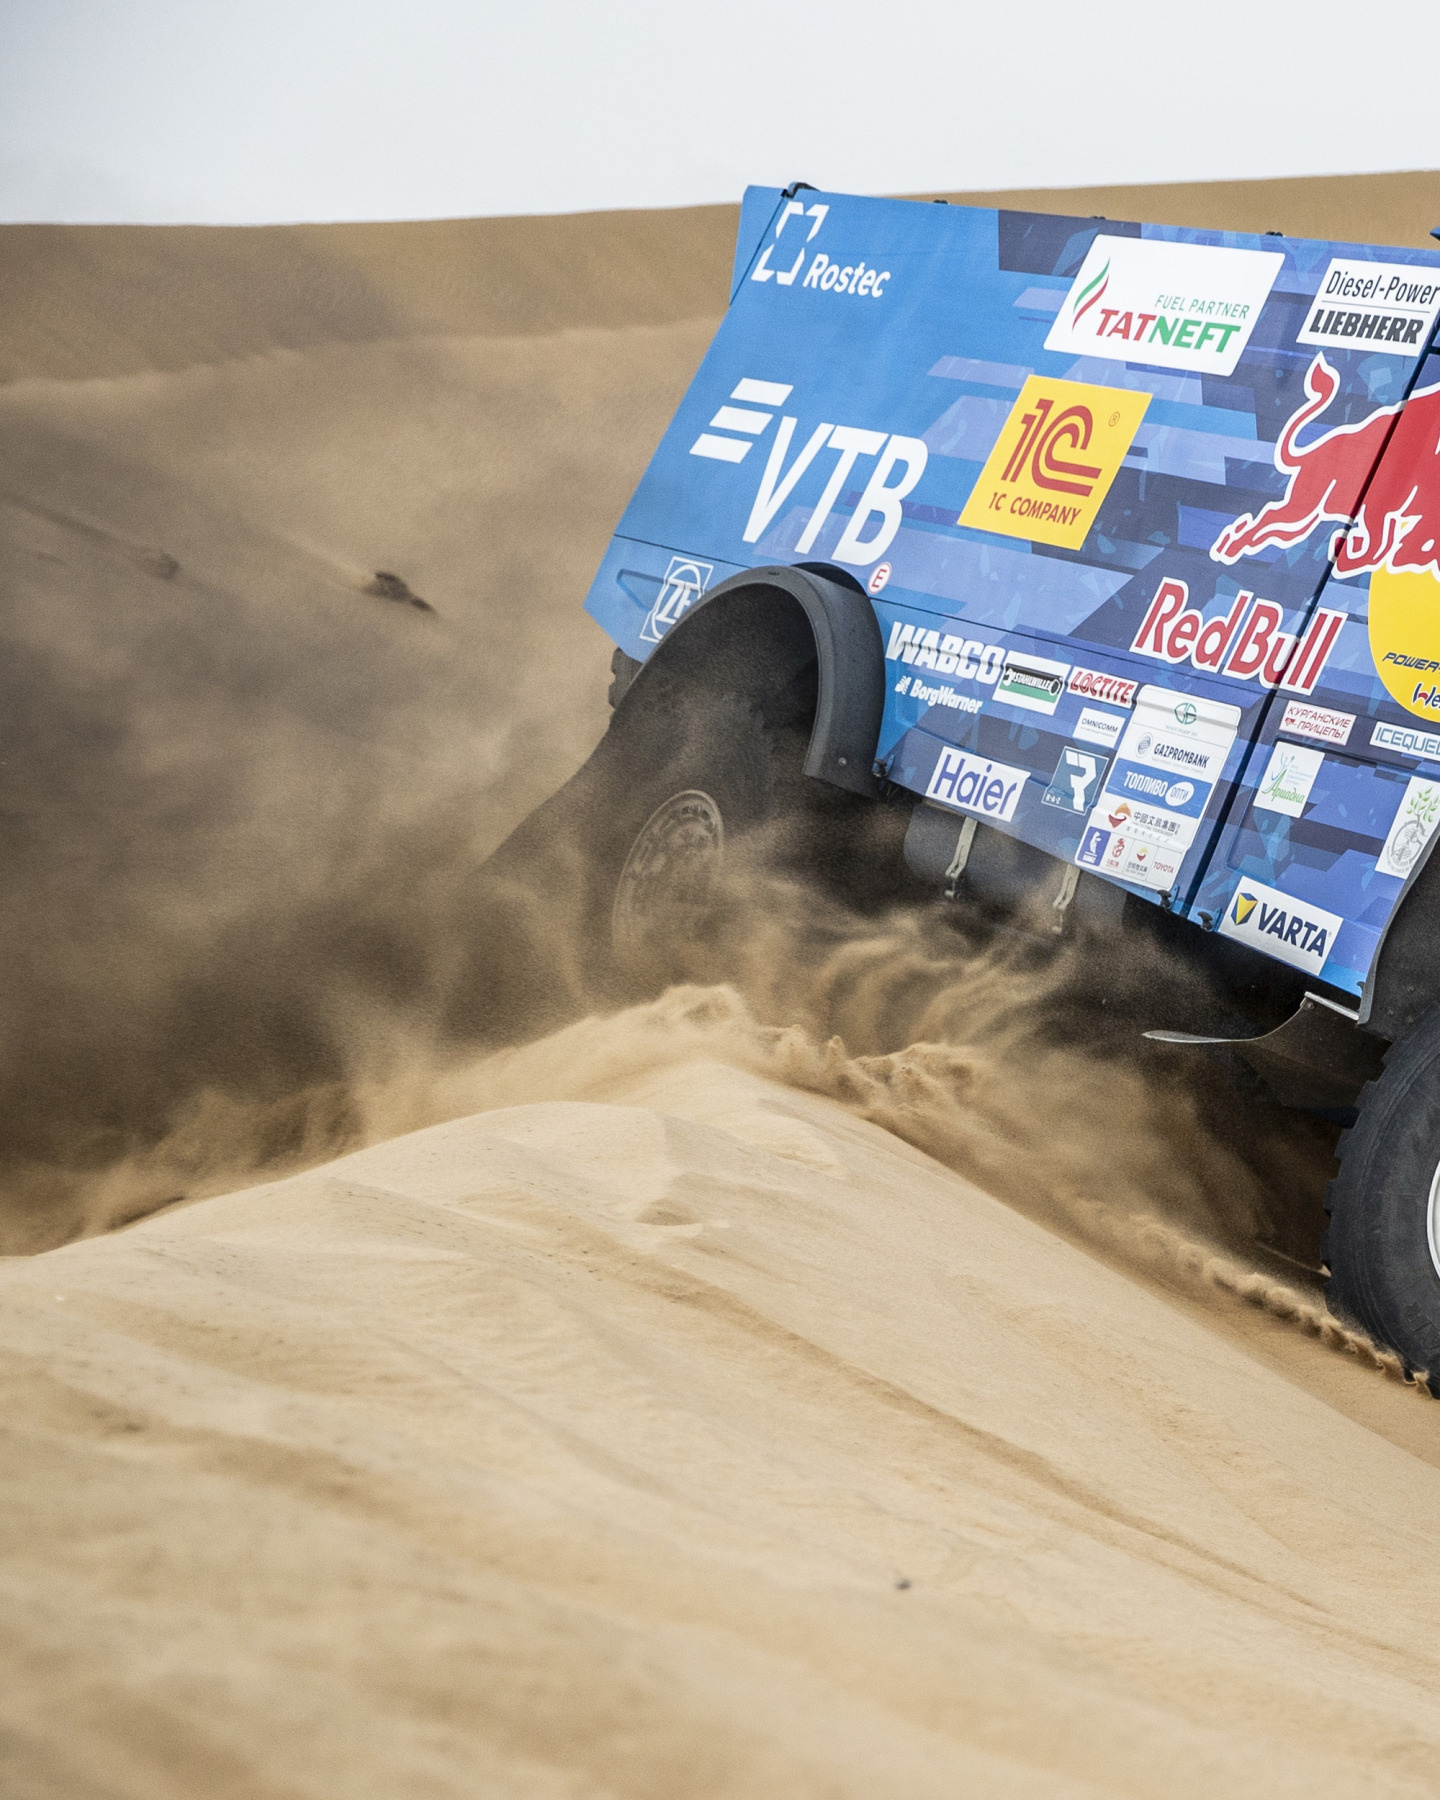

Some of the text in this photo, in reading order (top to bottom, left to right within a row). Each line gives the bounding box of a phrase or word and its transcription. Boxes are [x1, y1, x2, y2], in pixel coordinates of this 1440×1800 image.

[802, 253, 891, 298] Rostec
[1325, 270, 1440, 307] Diesel-Power
[1154, 294, 1250, 319] FUEL PARTNER
[1096, 308, 1242, 353] TATNEFT
[1309, 309, 1424, 345] LIEBHERR
[741, 415, 929, 566] VTB
[989, 492, 1082, 526] 1C COMPANY
[871, 568, 888, 589] E
[885, 621, 1006, 685] WABCO
[910, 678, 984, 715] BorgWarner
[1069, 670, 1135, 704] LOCTITE
[1287, 706, 1351, 729] КУРГАНСКИЕ
[1296, 720, 1345, 740] ПРИЦЕПЫ
[1153, 743, 1210, 769] GAZPROMBANK
[933, 753, 1017, 818] Haier
[1123, 771, 1169, 798] ТОПЛИВО
[1258, 902, 1328, 958] VARTA
